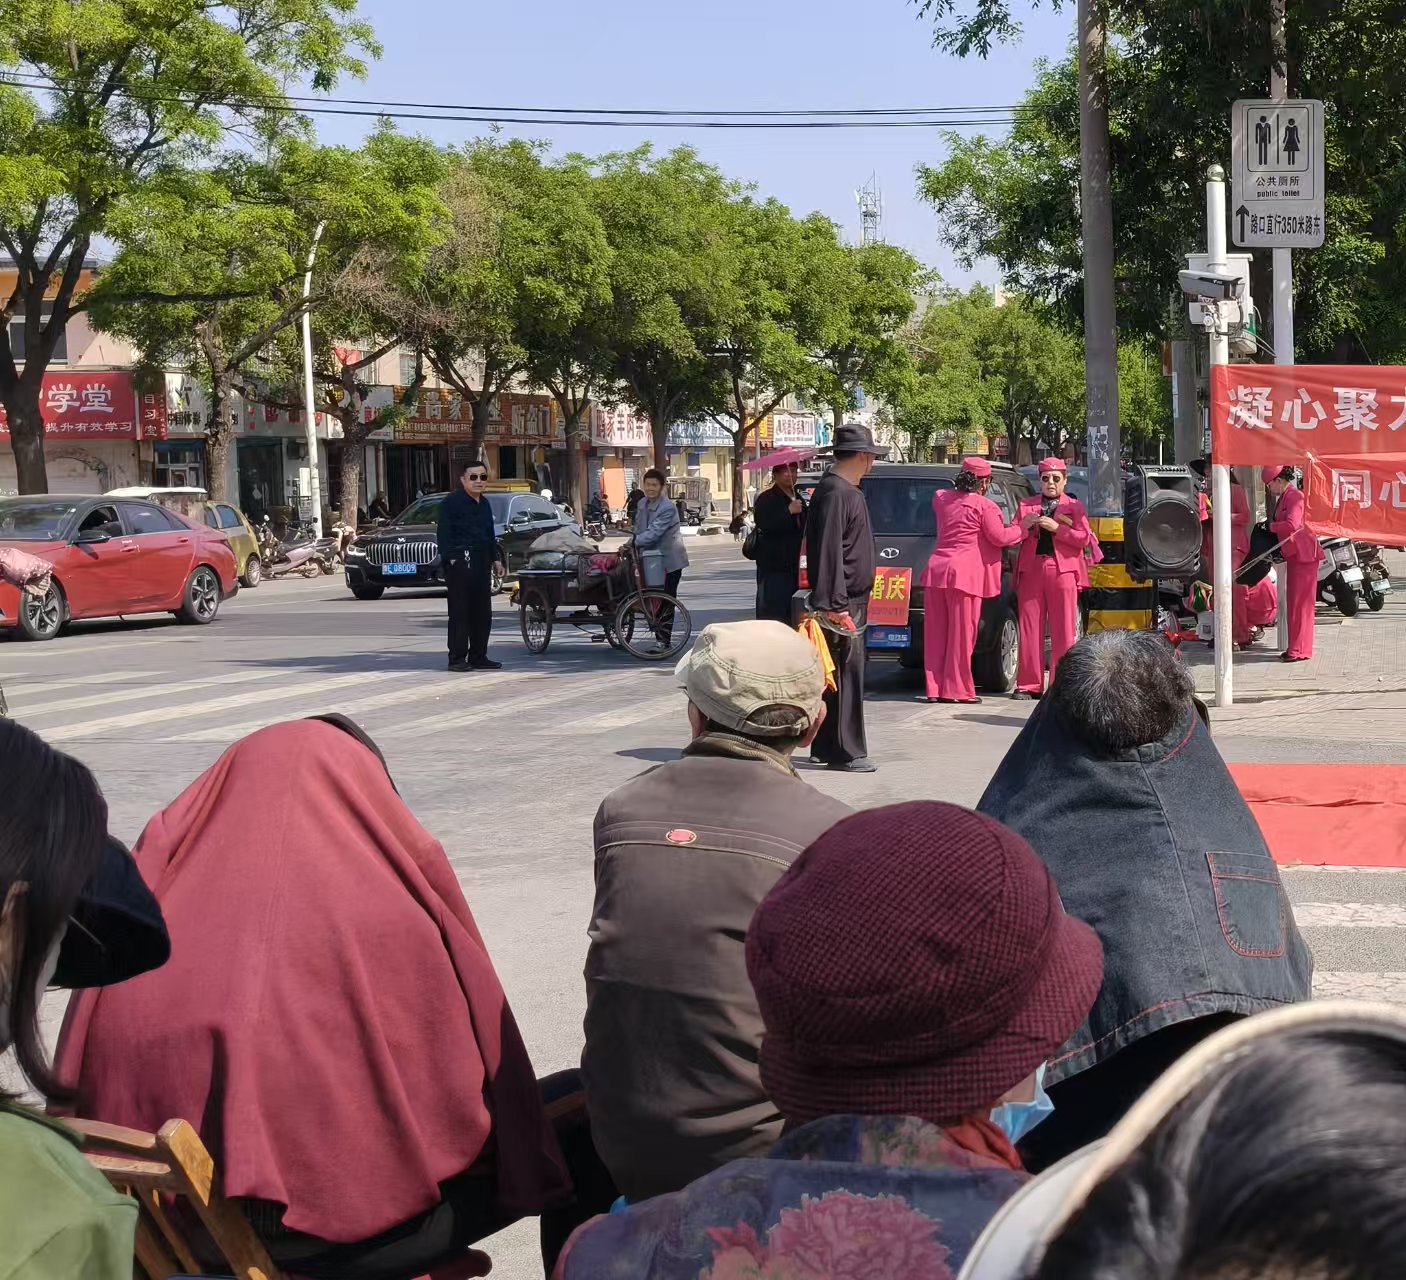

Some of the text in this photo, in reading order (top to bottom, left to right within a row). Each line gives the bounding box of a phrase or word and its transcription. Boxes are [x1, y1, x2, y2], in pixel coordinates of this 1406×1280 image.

[1256, 175, 1300, 187] 公共厕所
[39, 382, 114, 413] 学堂
[45, 421, 133, 432] 提升有效学习
